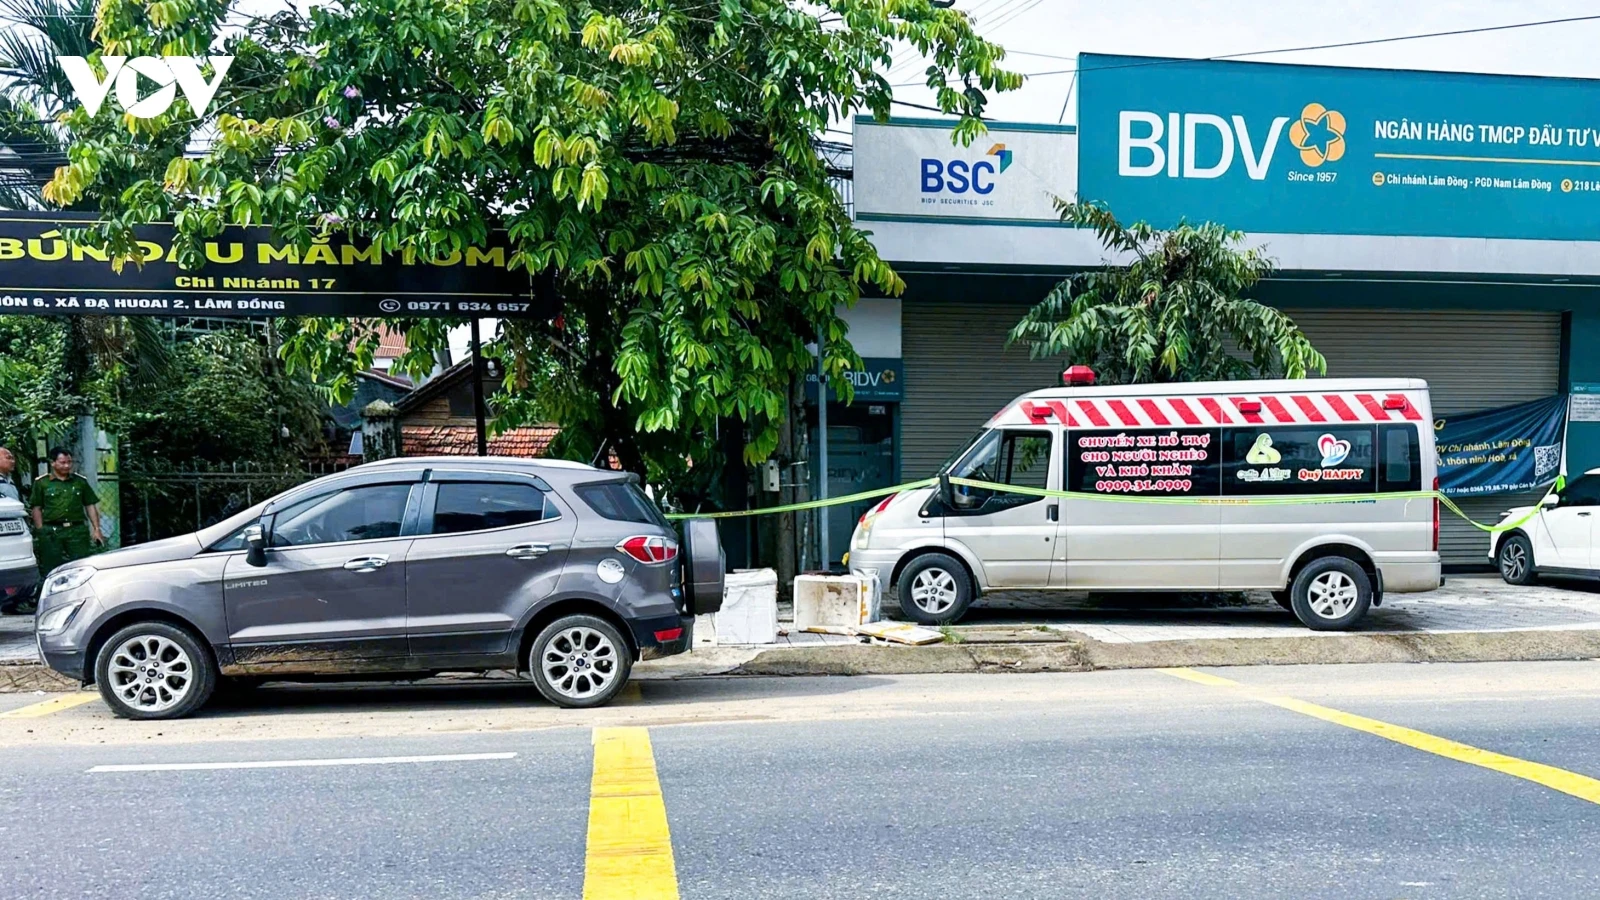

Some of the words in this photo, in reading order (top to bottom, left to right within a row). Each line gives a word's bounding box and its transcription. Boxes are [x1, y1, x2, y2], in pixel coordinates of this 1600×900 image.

[1375, 118, 1422, 140] NGÂN
[1427, 120, 1474, 142] HÀNG
[1479, 125, 1525, 144] TMCP
[1529, 124, 1562, 146] ĐẦU
[1567, 128, 1590, 147] TƯ
[1118, 110, 1290, 180] BIDV
[921, 158, 995, 194] BSC
[1287, 171, 1314, 182] Since
[1316, 172, 1337, 182] 1957
[1387, 174, 1401, 184] Chi
[1402, 174, 1427, 185] nhánh
[1429, 175, 1446, 186] Lâm
[1447, 173, 1468, 188] Đồng
[1475, 177, 1492, 187] PGD
[1494, 178, 1512, 188] Nam
[1513, 177, 1530, 189] Lâm
[1531, 176, 1552, 191] Đồng
[1574, 180, 1590, 190] 218
[175, 276, 214, 288] Chi
[223, 276, 300, 289] Nhánh
[307, 278, 336, 289] 17
[0, 295, 28, 307] ÔN
[55, 296, 80, 308] XÃ
[84, 298, 109, 309] ĐẠ
[115, 298, 168, 309] HUOAI
[194, 297, 232, 309] LÂM
[407, 301, 450, 311] 0971
[458, 302, 492, 311] 634
[497, 302, 530, 312] 657
[843, 371, 881, 387] BIDV
[1078, 433, 1134, 447] CHUYẾN
[1137, 436, 1156, 447] XE
[1158, 432, 1179, 446] HỖ
[1181, 433, 1211, 448] TRỢ
[1448, 444, 1461, 452] Chi
[1463, 441, 1490, 452] nhánh
[1492, 440, 1510, 449] Lâm
[1081, 451, 1110, 462] CHO
[1112, 449, 1157, 461] NGƯỜI
[1159, 448, 1208, 461] NGHÈO
[1447, 455, 1468, 465] thôn
[1096, 464, 1116, 477] VÀ
[1118, 463, 1149, 476] KHÓ
[1151, 463, 1192, 476] KHĂN
[1323, 469, 1364, 480] HAPPY
[1095, 479, 1192, 492] 0909.31.0909
[225, 579, 268, 590] LIMITED
